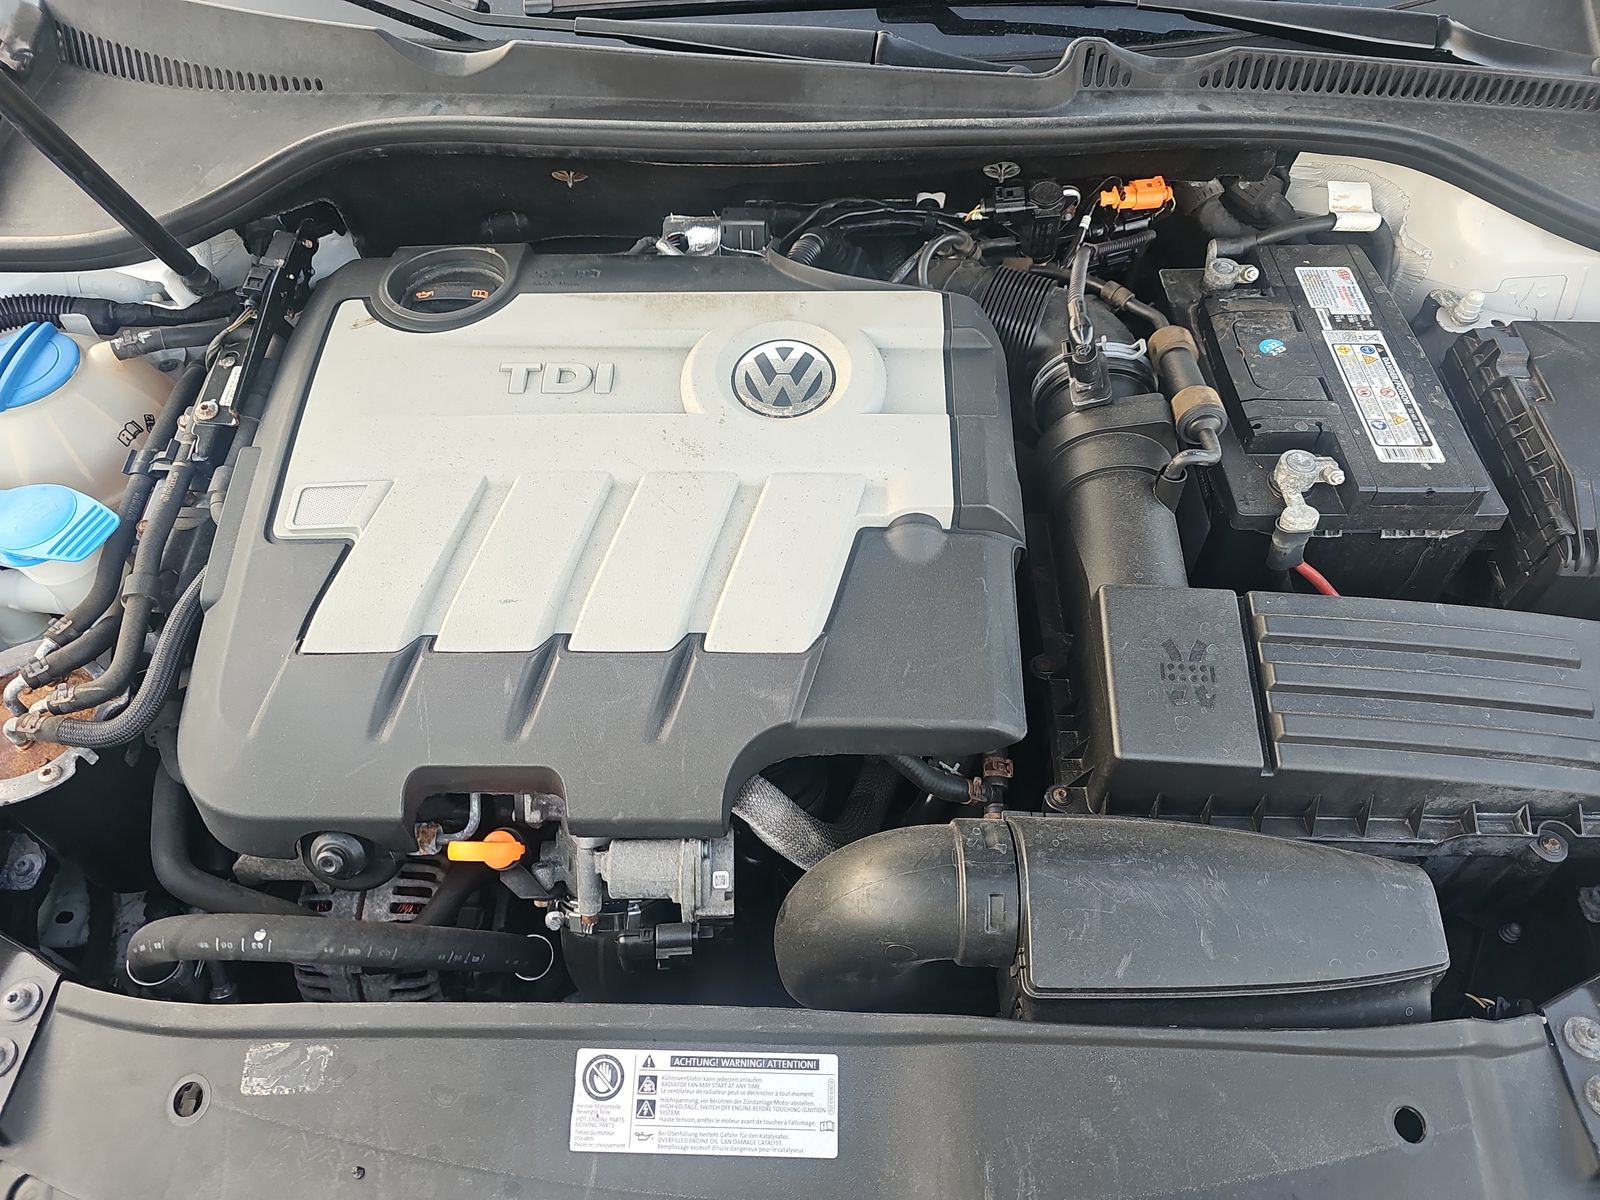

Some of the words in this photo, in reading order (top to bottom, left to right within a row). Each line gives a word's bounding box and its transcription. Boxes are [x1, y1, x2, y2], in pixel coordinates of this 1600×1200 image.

[499, 362, 615, 394] TDI
[673, 1057, 719, 1067] ACHTUNG!
[721, 1058, 765, 1068] WARNING!
[767, 1060, 817, 1070] ATTENTION!
